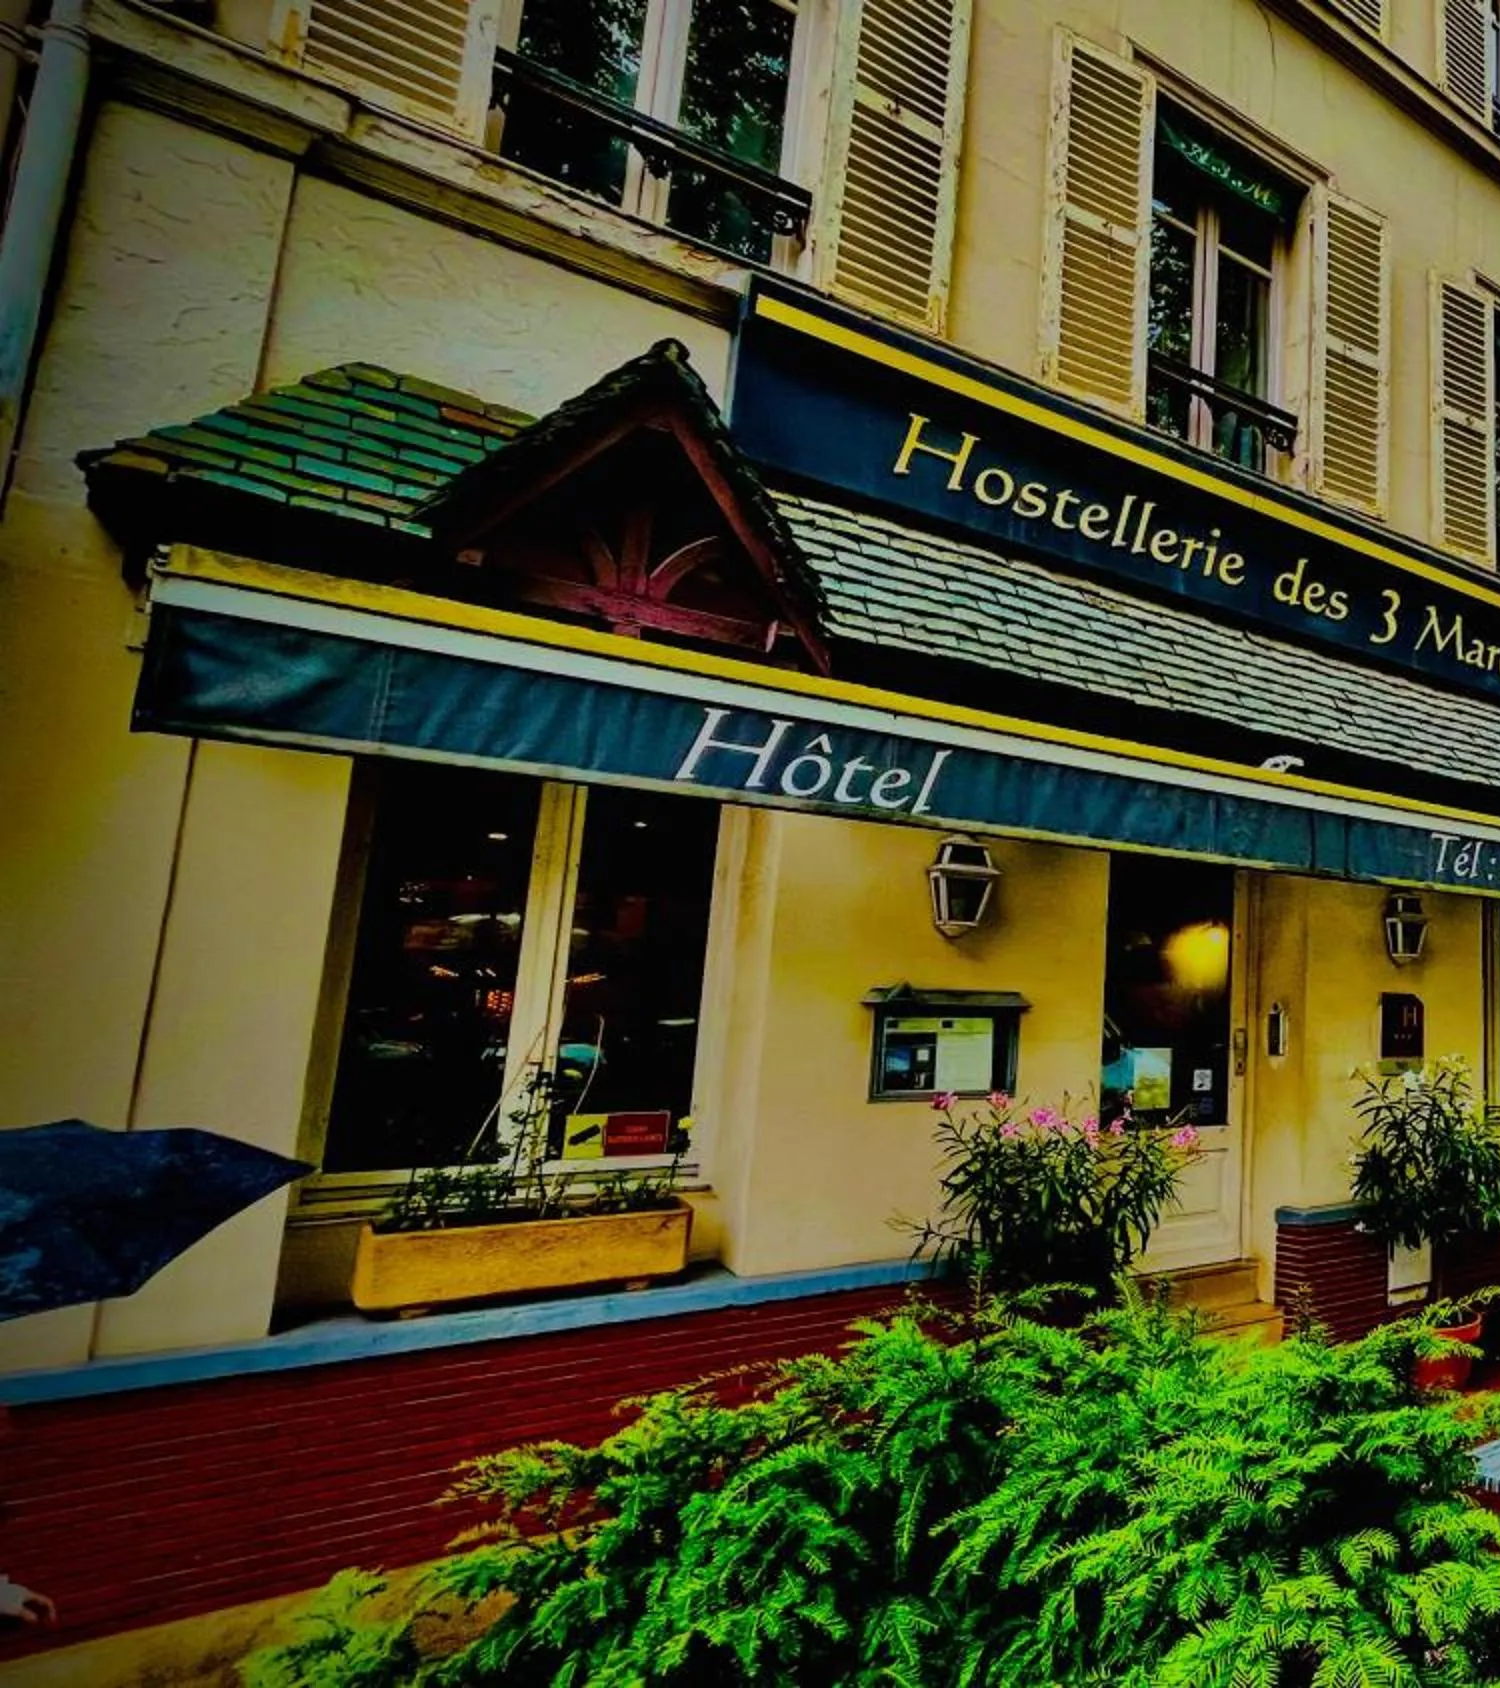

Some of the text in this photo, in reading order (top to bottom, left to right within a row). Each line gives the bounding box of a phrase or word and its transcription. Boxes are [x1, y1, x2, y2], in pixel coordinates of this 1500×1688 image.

[893, 412, 1246, 586] Hostellerie
[1273, 558, 1349, 621] des
[1369, 589, 1400, 644] 3
[674, 706, 953, 814] Hôtel
[1403, 1006, 1418, 1027] H
